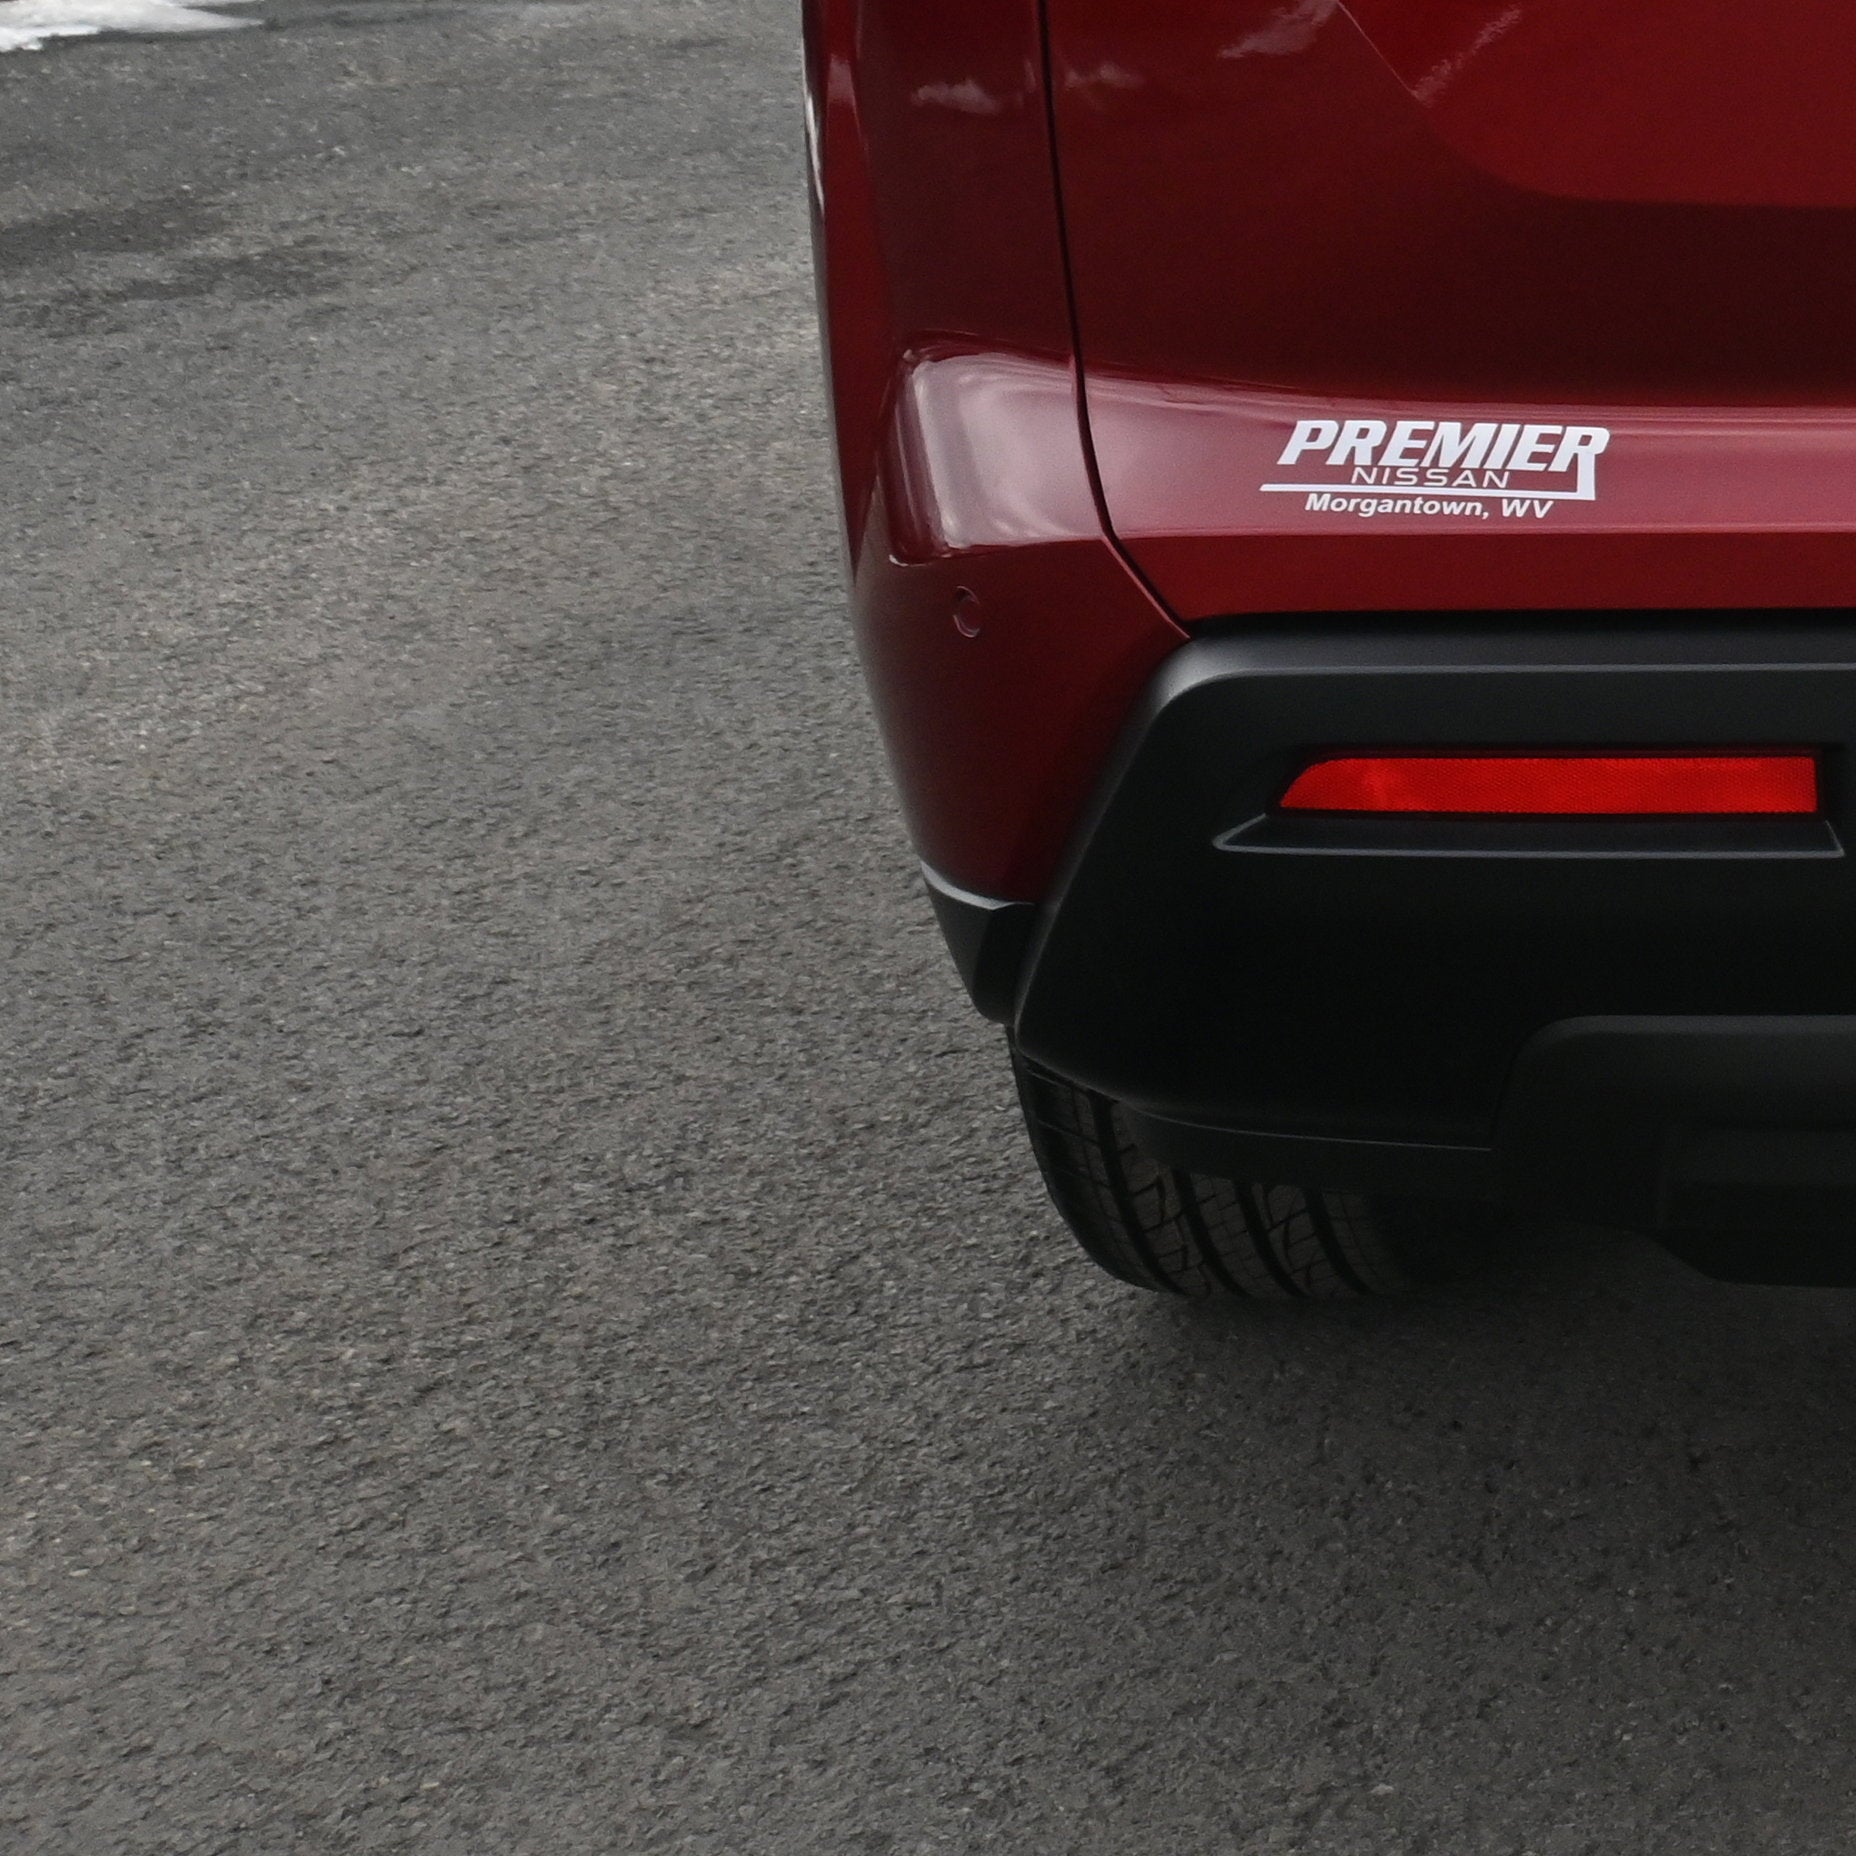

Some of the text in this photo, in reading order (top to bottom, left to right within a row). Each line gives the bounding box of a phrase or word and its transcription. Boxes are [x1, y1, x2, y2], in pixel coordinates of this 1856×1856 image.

[1277, 420, 1610, 500] PREMIER
[1350, 466, 1510, 488] NISSAN
[1304, 493, 1554, 520] Morgantown, WV
